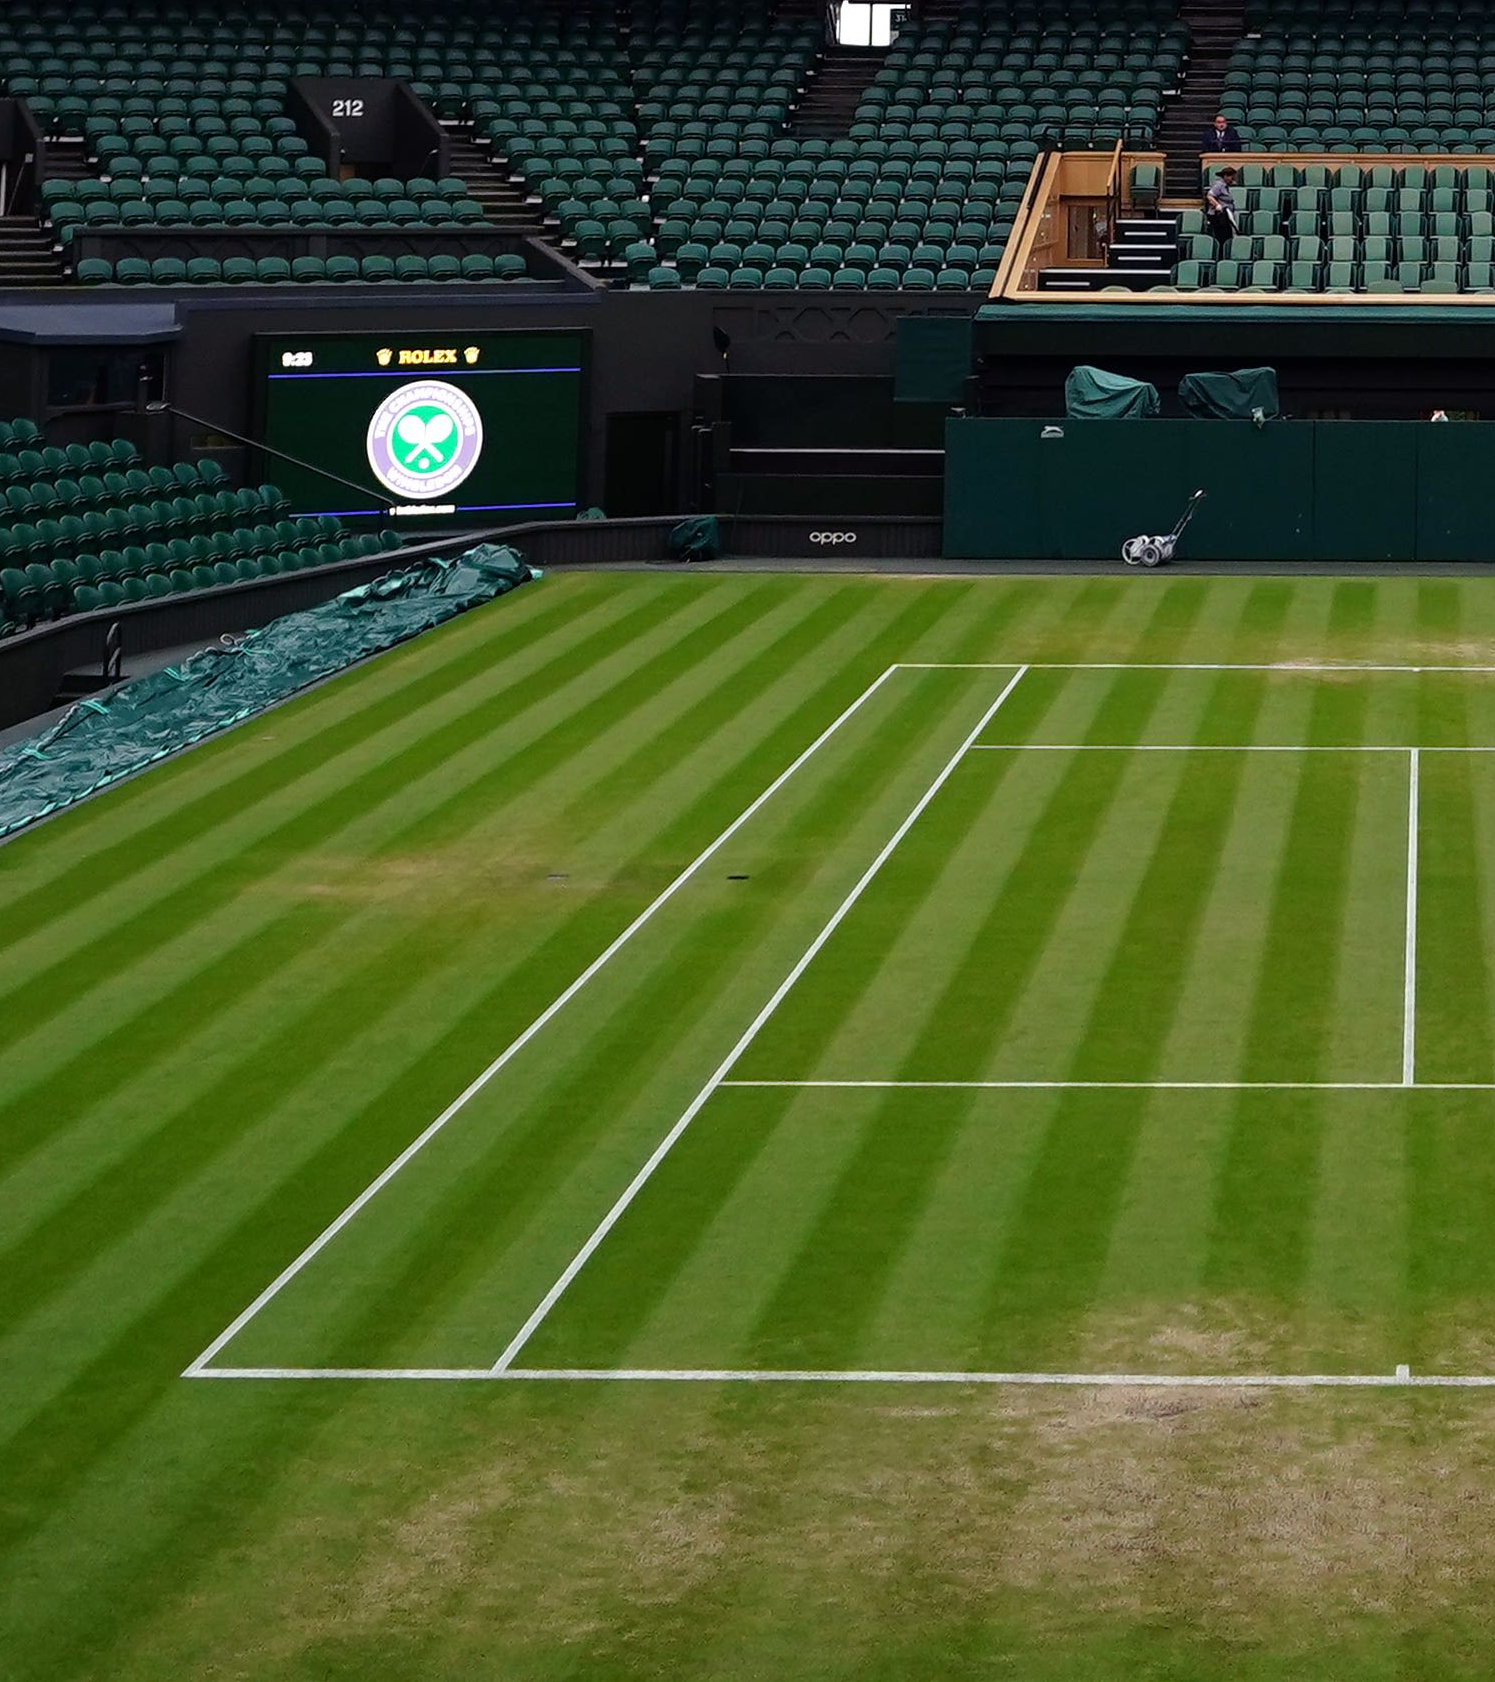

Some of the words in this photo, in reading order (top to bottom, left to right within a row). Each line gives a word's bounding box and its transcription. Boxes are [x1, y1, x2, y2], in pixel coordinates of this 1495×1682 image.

[332, 99, 364, 117] 212
[399, 349, 457, 364] ROLEX
[809, 531, 857, 545] oppo
